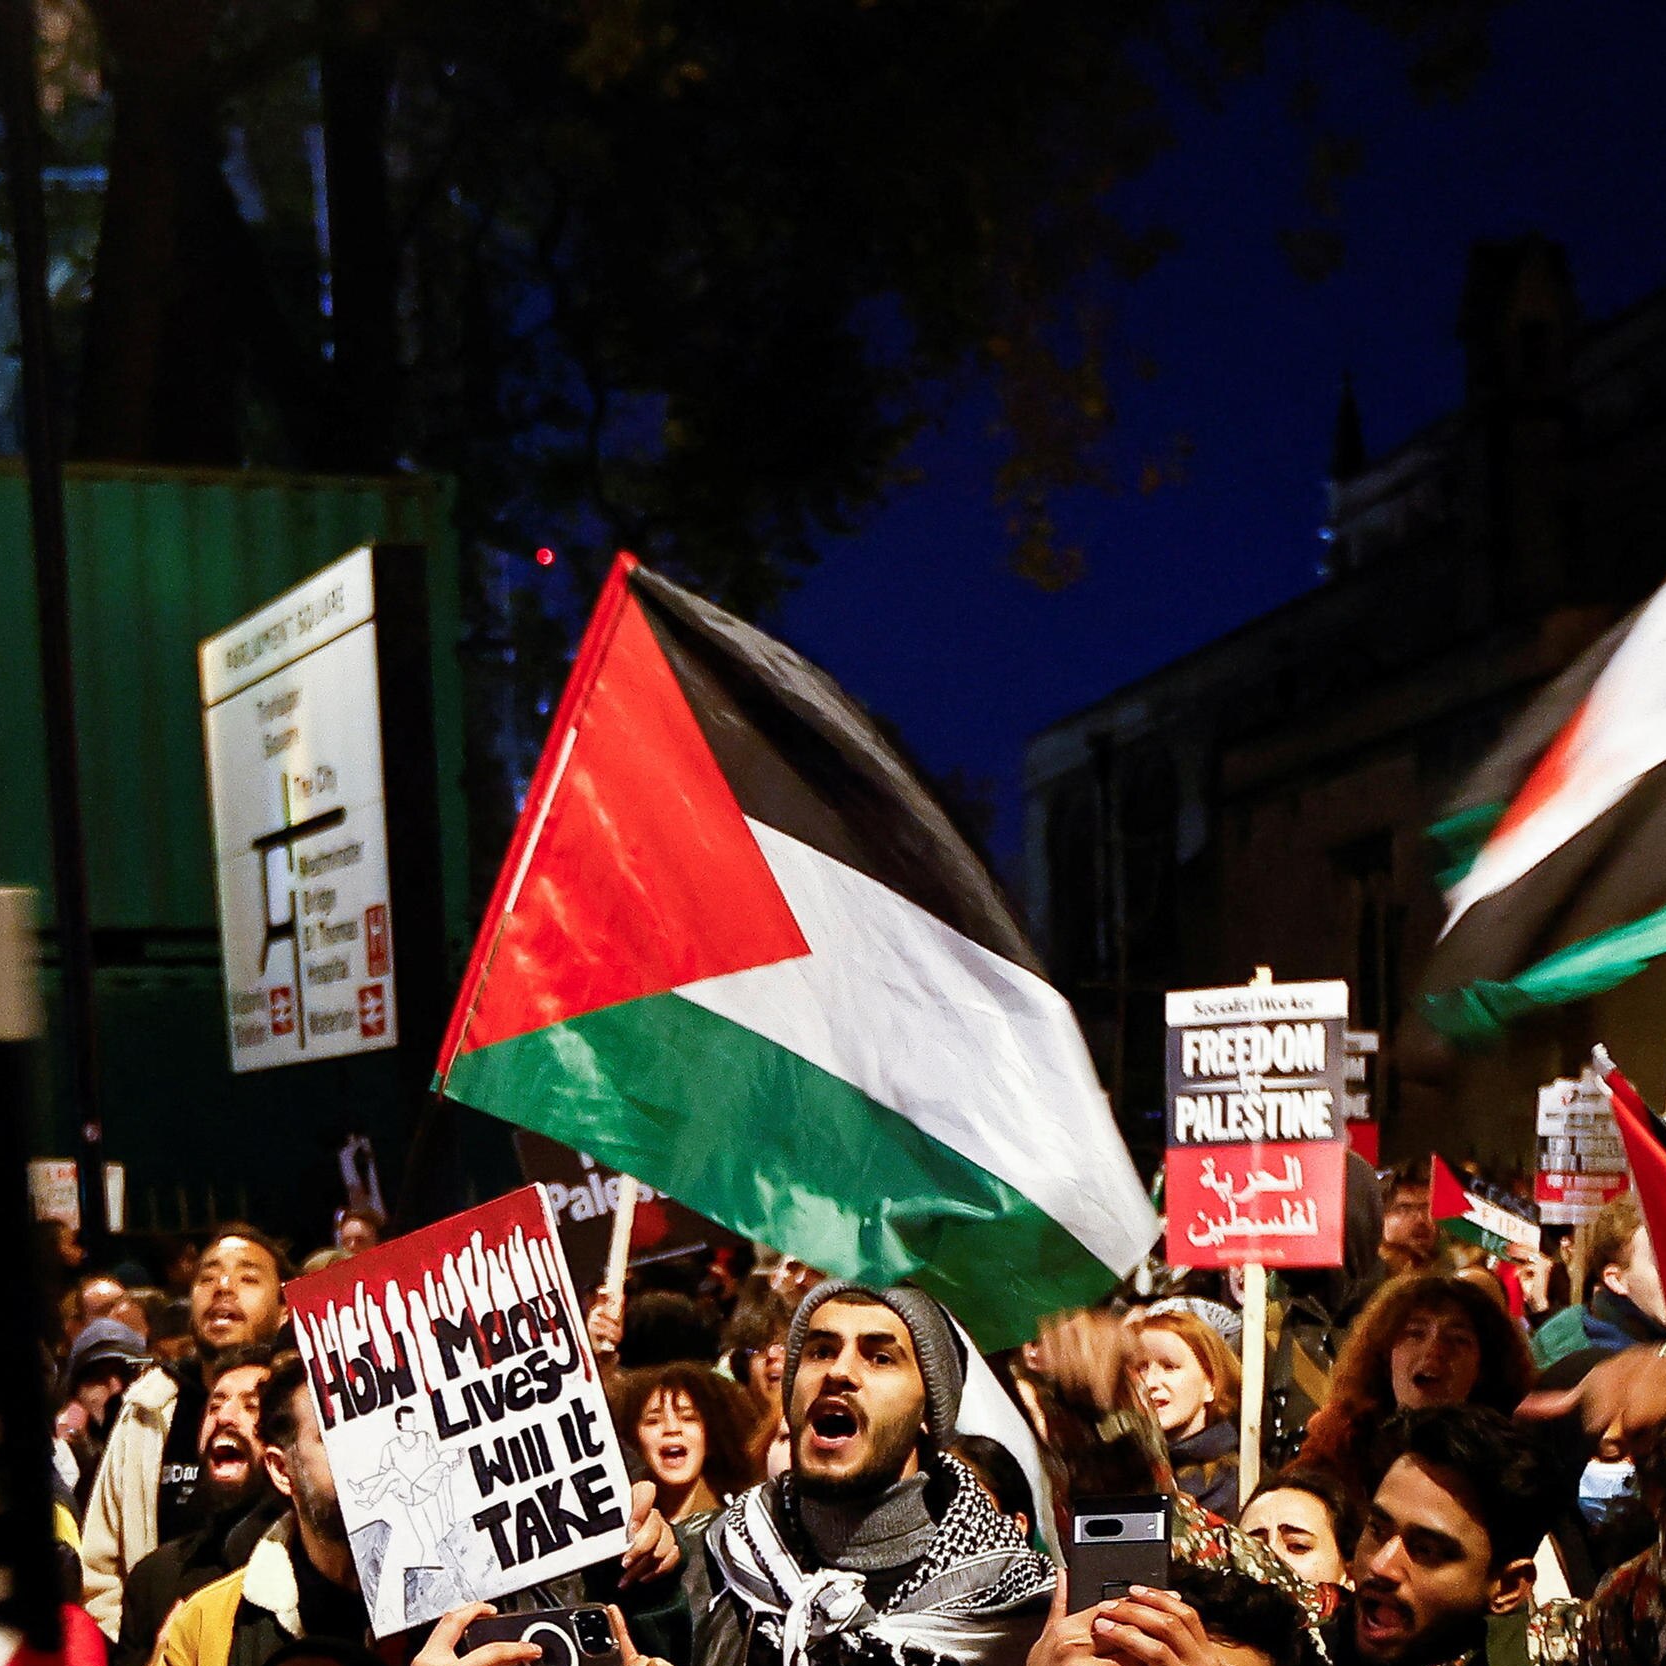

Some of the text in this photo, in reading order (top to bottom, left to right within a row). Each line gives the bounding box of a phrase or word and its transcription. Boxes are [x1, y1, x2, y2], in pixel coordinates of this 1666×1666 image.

[1182, 1023, 1328, 1077] FREEDOM
[1174, 1089, 1335, 1143] PALESTINE
[430, 1288, 581, 1381] Many
[557, 1397, 606, 1465] It
[472, 1463, 626, 1572] TAKE
